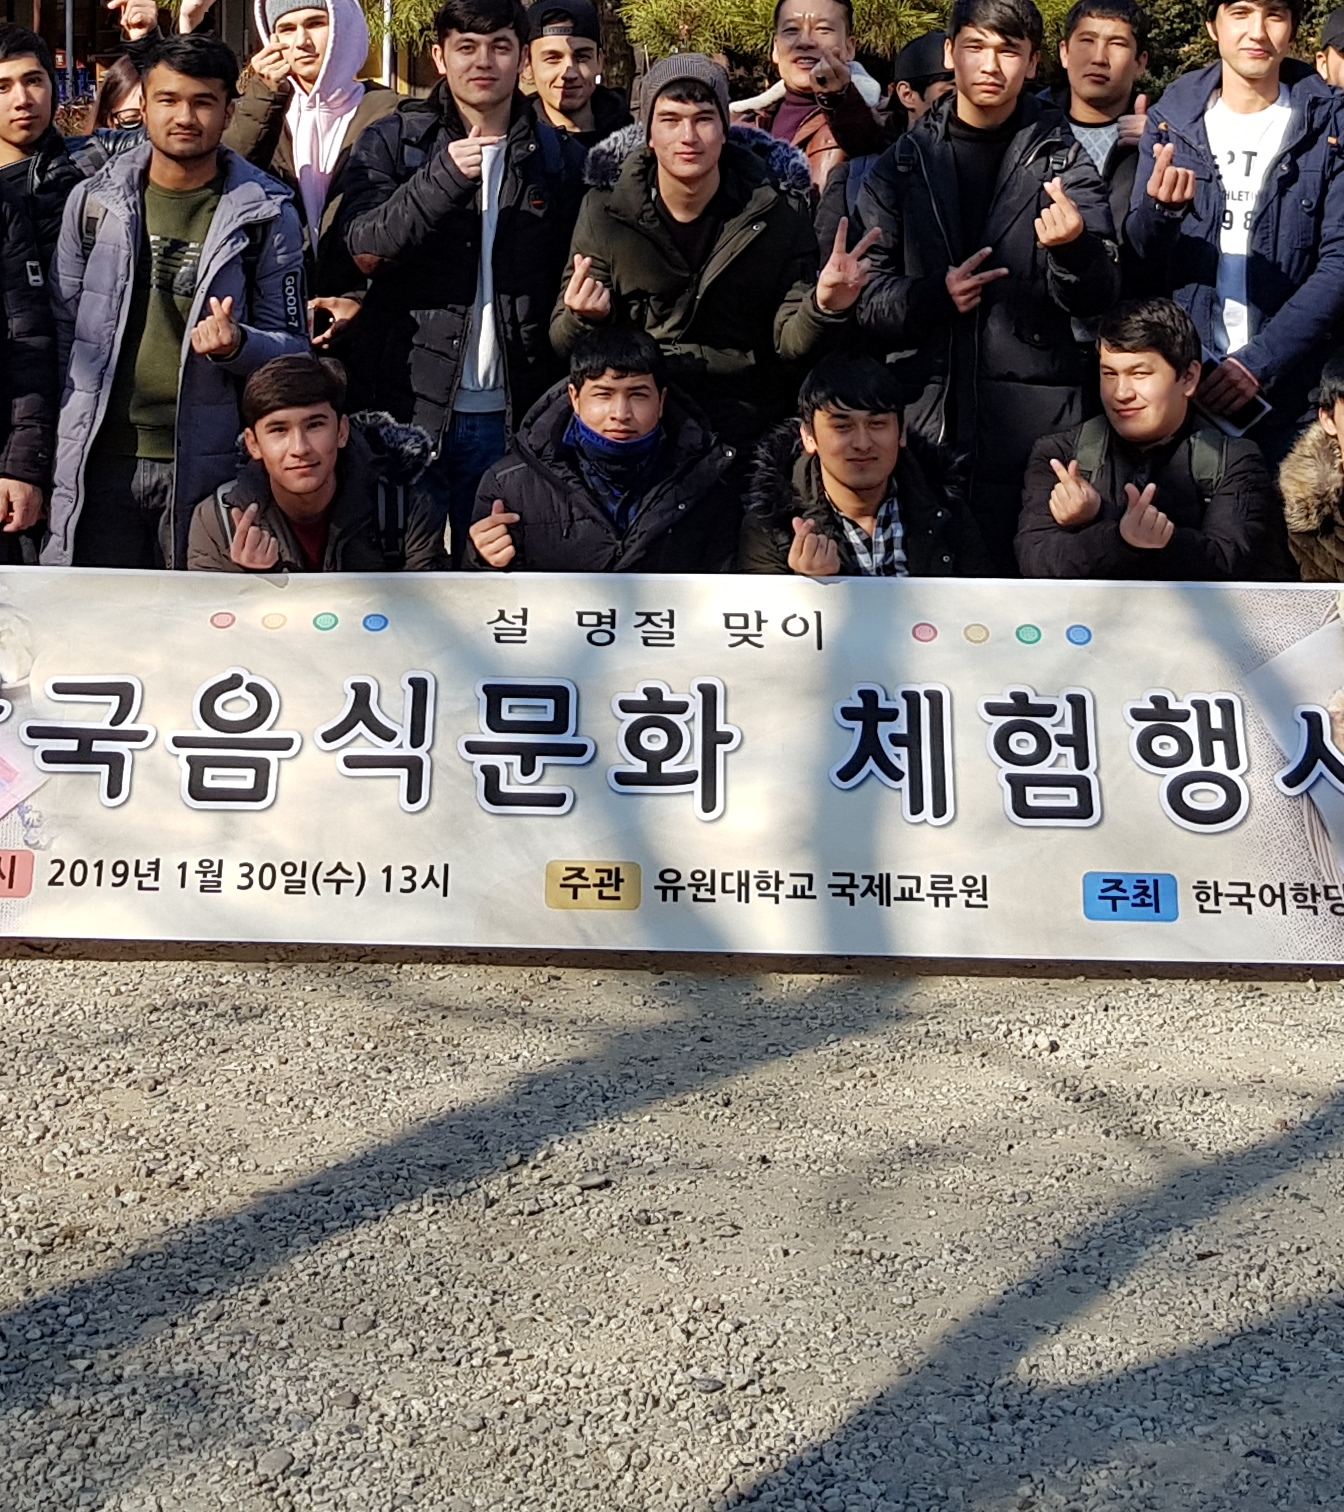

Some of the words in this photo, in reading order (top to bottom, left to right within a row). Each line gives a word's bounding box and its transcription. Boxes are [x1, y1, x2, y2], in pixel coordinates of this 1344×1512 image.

[285, 276, 298, 327] GOOD-7
[486, 607, 528, 645] 설
[575, 607, 675, 649] 명절
[723, 610, 824, 651] 맞이
[47, 858, 161, 892] 2019년
[177, 858, 224, 893] 1월
[236, 859, 367, 898] 30일(수)
[381, 863, 450, 898] 13시
[559, 866, 626, 902] 주관
[653, 867, 818, 905] 유원대학교
[827, 871, 989, 909] 국제교류원
[1097, 873, 1164, 914] 주최
